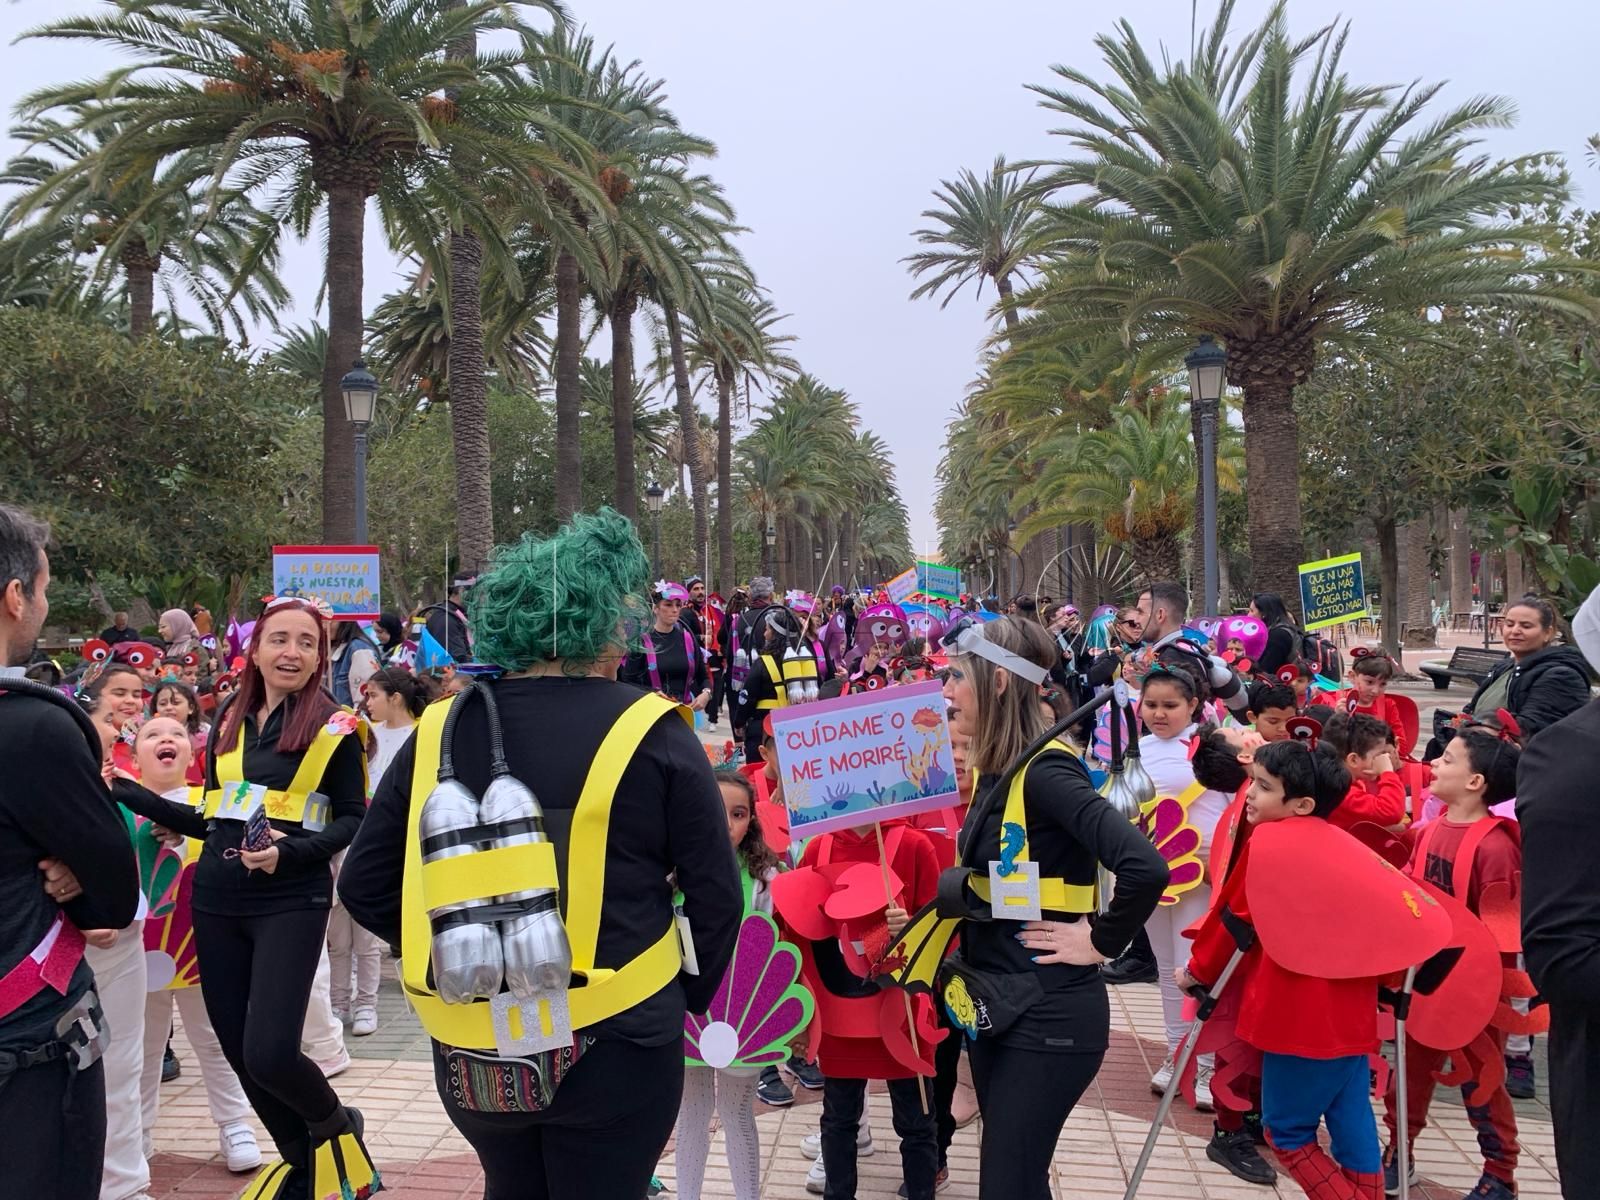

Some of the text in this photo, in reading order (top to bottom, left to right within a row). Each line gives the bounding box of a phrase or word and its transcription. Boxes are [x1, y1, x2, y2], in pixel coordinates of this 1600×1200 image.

[290, 562, 369, 575] LA BASURA
[1309, 566, 1354, 585] QUE NI UNA
[290, 576, 364, 588] ES NUESTRA
[1311, 582, 1336, 596] BOLSA
[1316, 590, 1352, 606] CAIGA EN
[1307, 599, 1362, 620] NUESTRO MAR
[786, 712, 905, 750] CUÍDAME O
[791, 735, 907, 784] ME MORIRÉ
